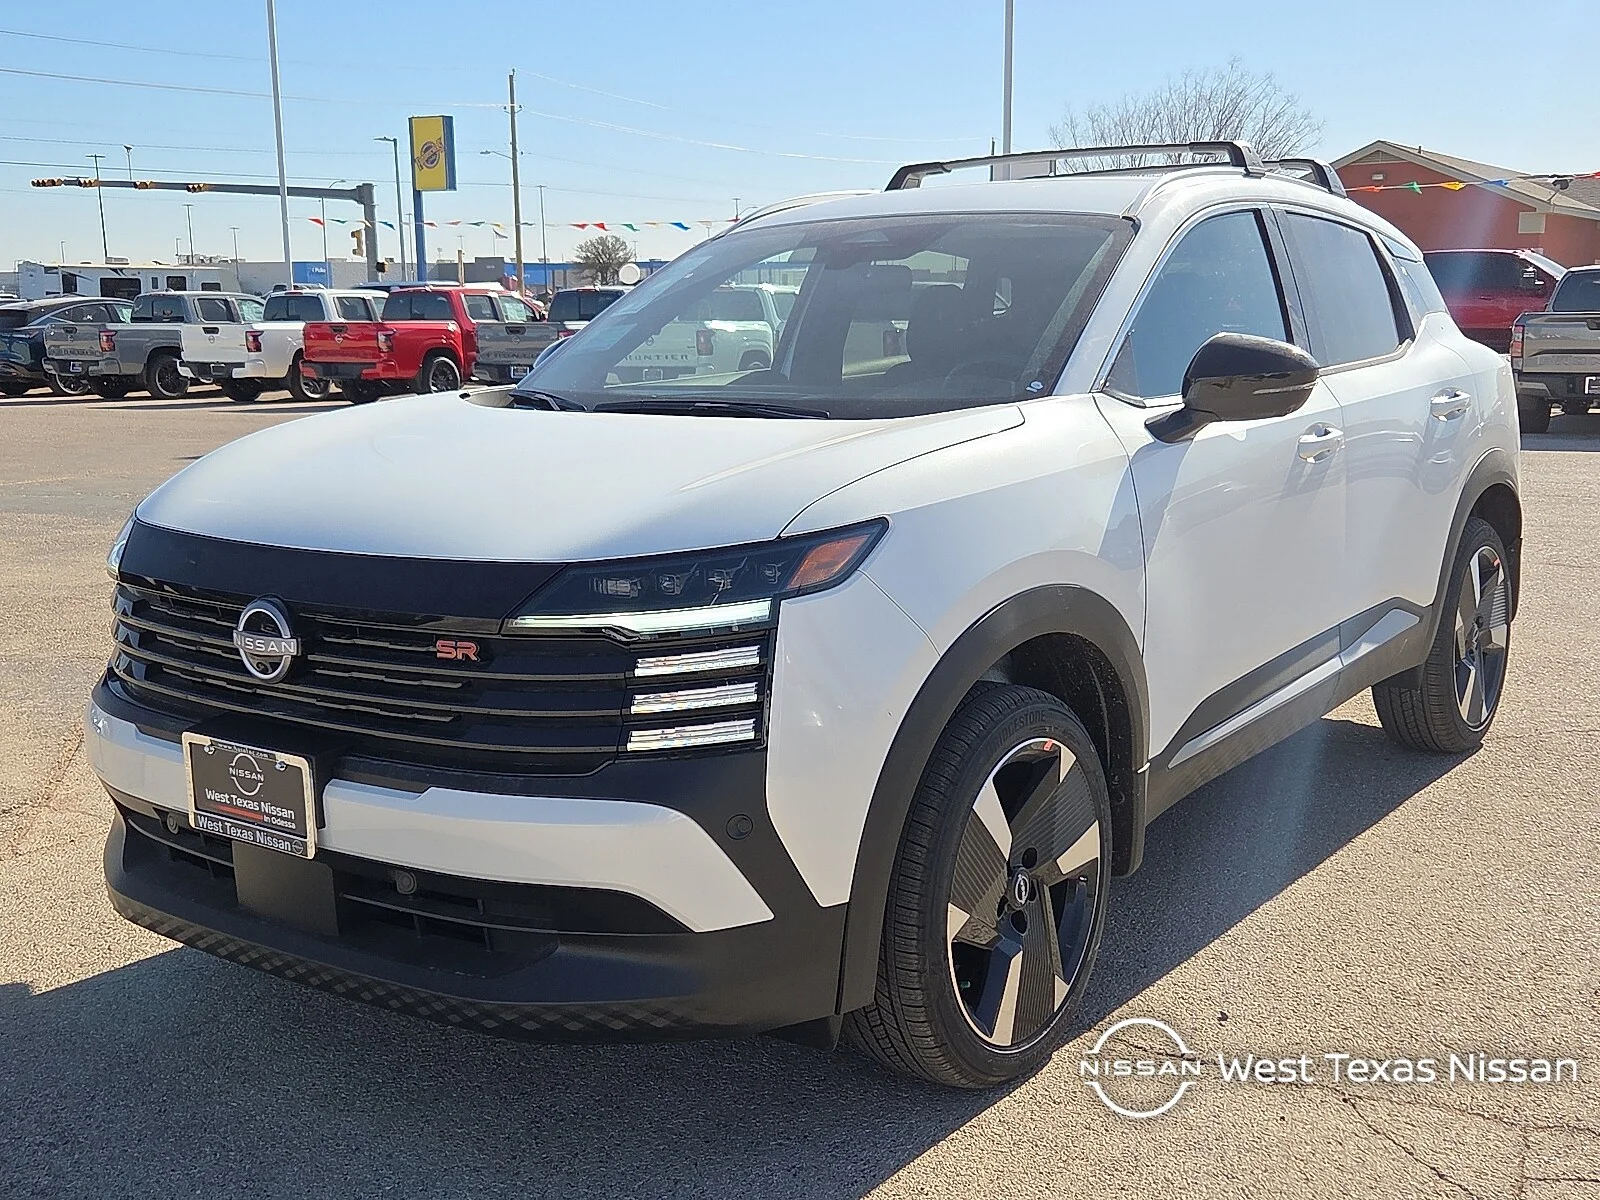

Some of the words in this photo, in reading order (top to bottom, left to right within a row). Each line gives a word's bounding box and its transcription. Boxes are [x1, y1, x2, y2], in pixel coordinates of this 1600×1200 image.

[233, 632, 296, 653] NISSAN
[435, 639, 480, 662] SR
[228, 766, 265, 782] NISSAN
[205, 788, 231, 804] West
[230, 794, 260, 811] Texas
[260, 801, 295, 820] Nissan
[197, 815, 223, 830] West
[224, 820, 254, 841] Texas
[255, 830, 292, 852] Nissan
[270, 816, 296, 830] Odessa
